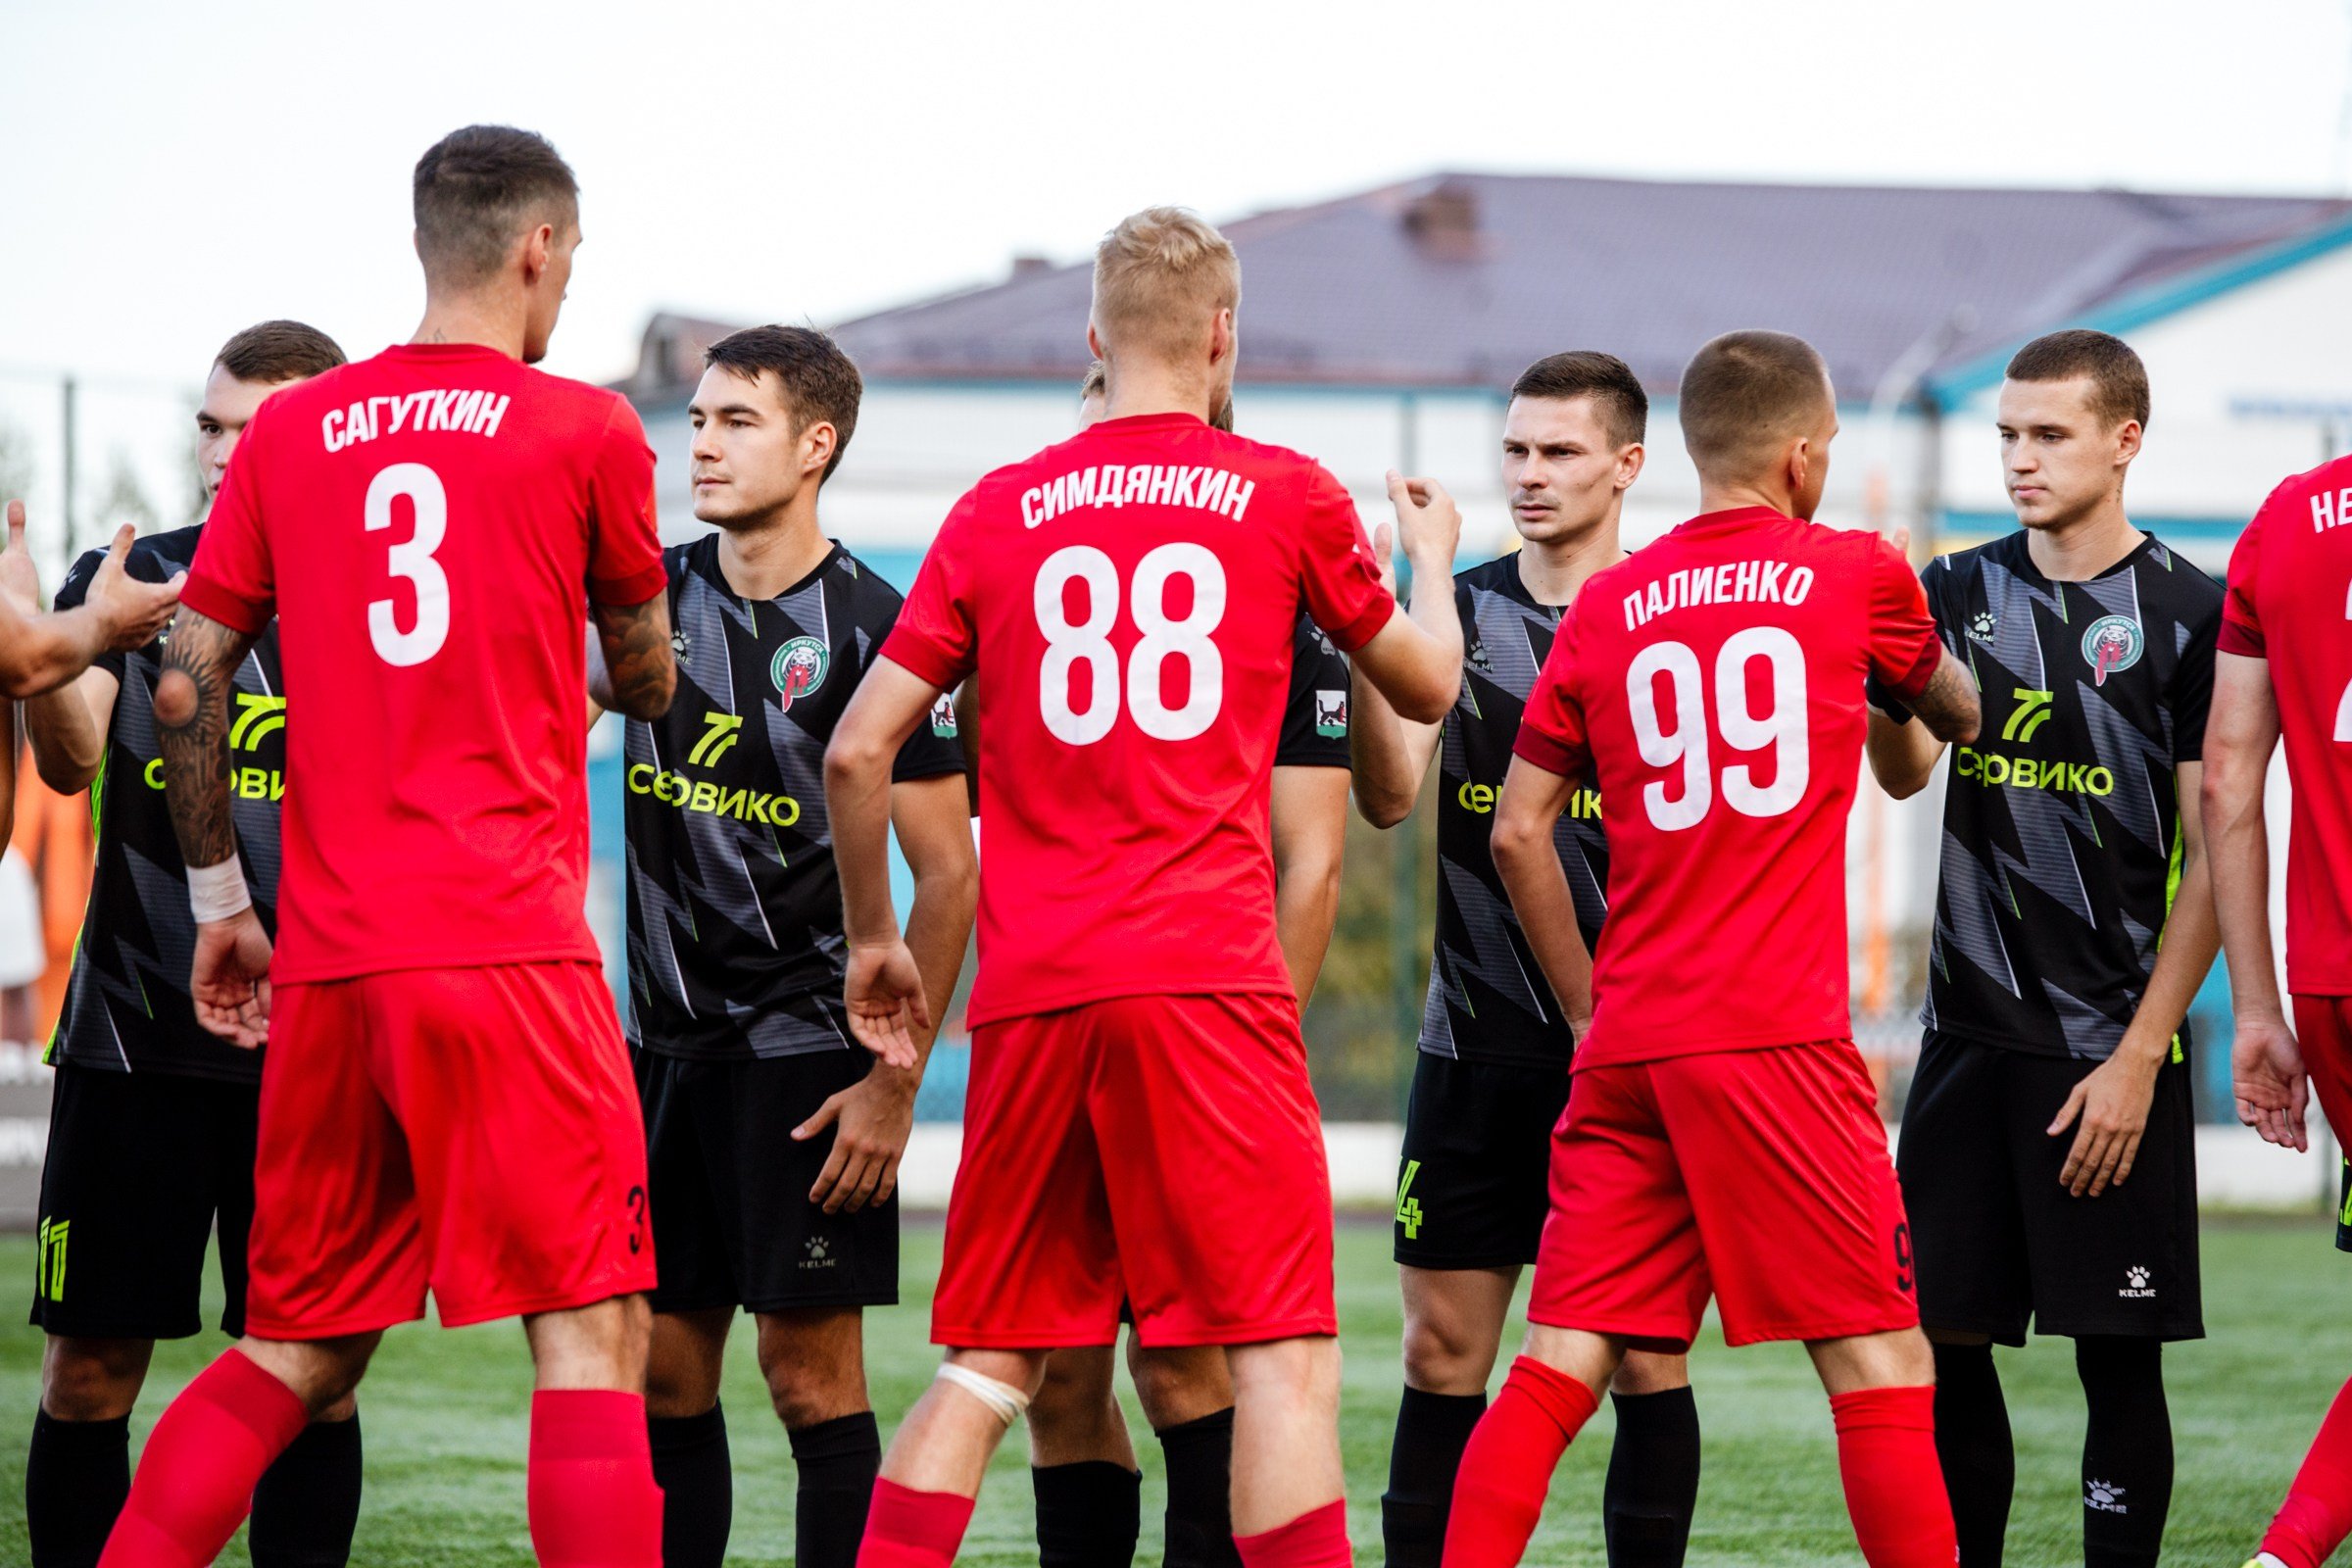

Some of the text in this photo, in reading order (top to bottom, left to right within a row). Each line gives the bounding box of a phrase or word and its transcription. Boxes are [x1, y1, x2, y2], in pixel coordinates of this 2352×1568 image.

[321, 389, 511, 453] САГУТКИН
[1020, 465, 1255, 530] СИМДЯНКИН
[364, 463, 450, 667] 3
[1623, 560, 1814, 632] ПАЛИЕНКО
[1033, 541, 1227, 746] 88
[1626, 625, 1809, 832] 99
[627, 1185, 646, 1255] 3
[1396, 1159, 1423, 1240] 4
[798, 1258, 836, 1270] KELME
[2118, 1288, 2157, 1298] KELME
